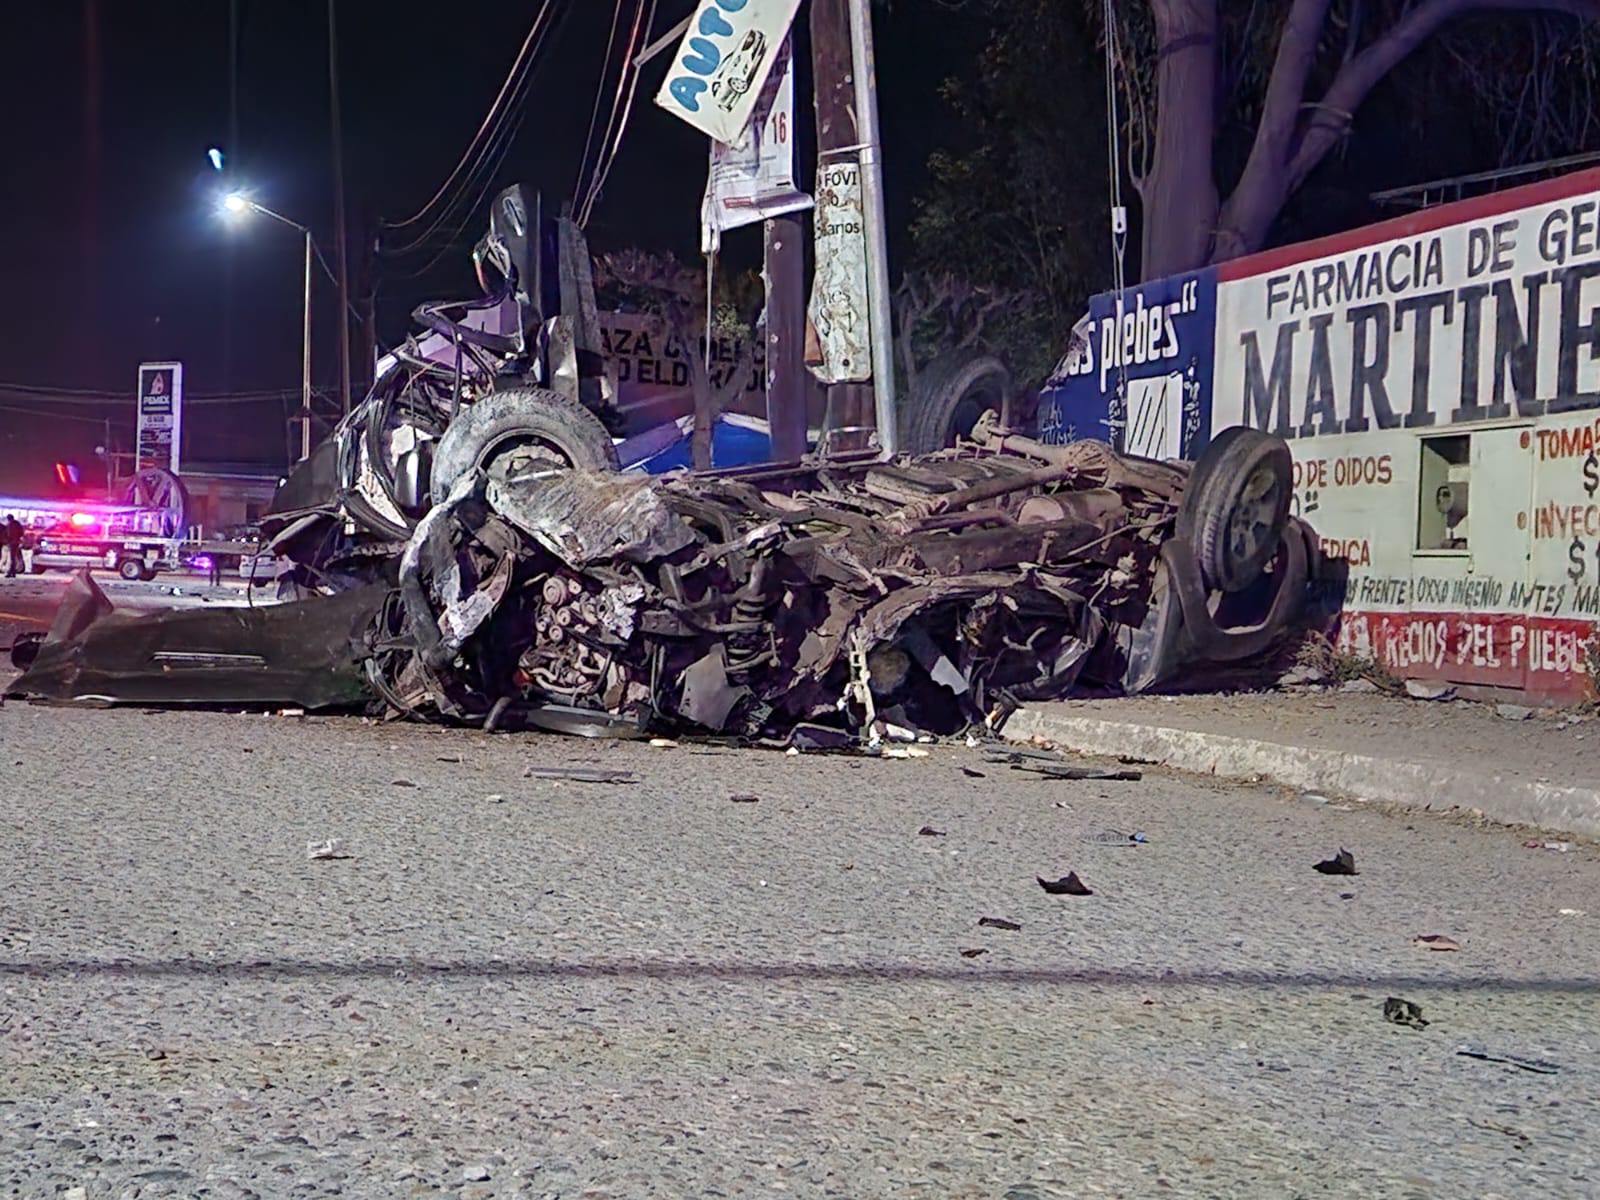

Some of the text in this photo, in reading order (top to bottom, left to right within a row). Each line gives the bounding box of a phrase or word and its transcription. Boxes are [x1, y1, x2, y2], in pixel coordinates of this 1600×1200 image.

[1266, 200, 1600, 320] FARMACIA DE GE
[600, 327, 653, 357] AZA
[1239, 262, 1600, 440] MARTINE
[1306, 459, 1327, 488] DE
[1334, 455, 1392, 486] OIDOS
[1534, 500, 1600, 540] INYEC
[1320, 538, 1371, 567] EDICA
[1360, 575, 1407, 605] FRENTE
[1417, 576, 1450, 603] OXXO
[1508, 578, 1566, 616] ANTES
[1572, 584, 1600, 615] MA
[1511, 624, 1588, 674] PUEBL
